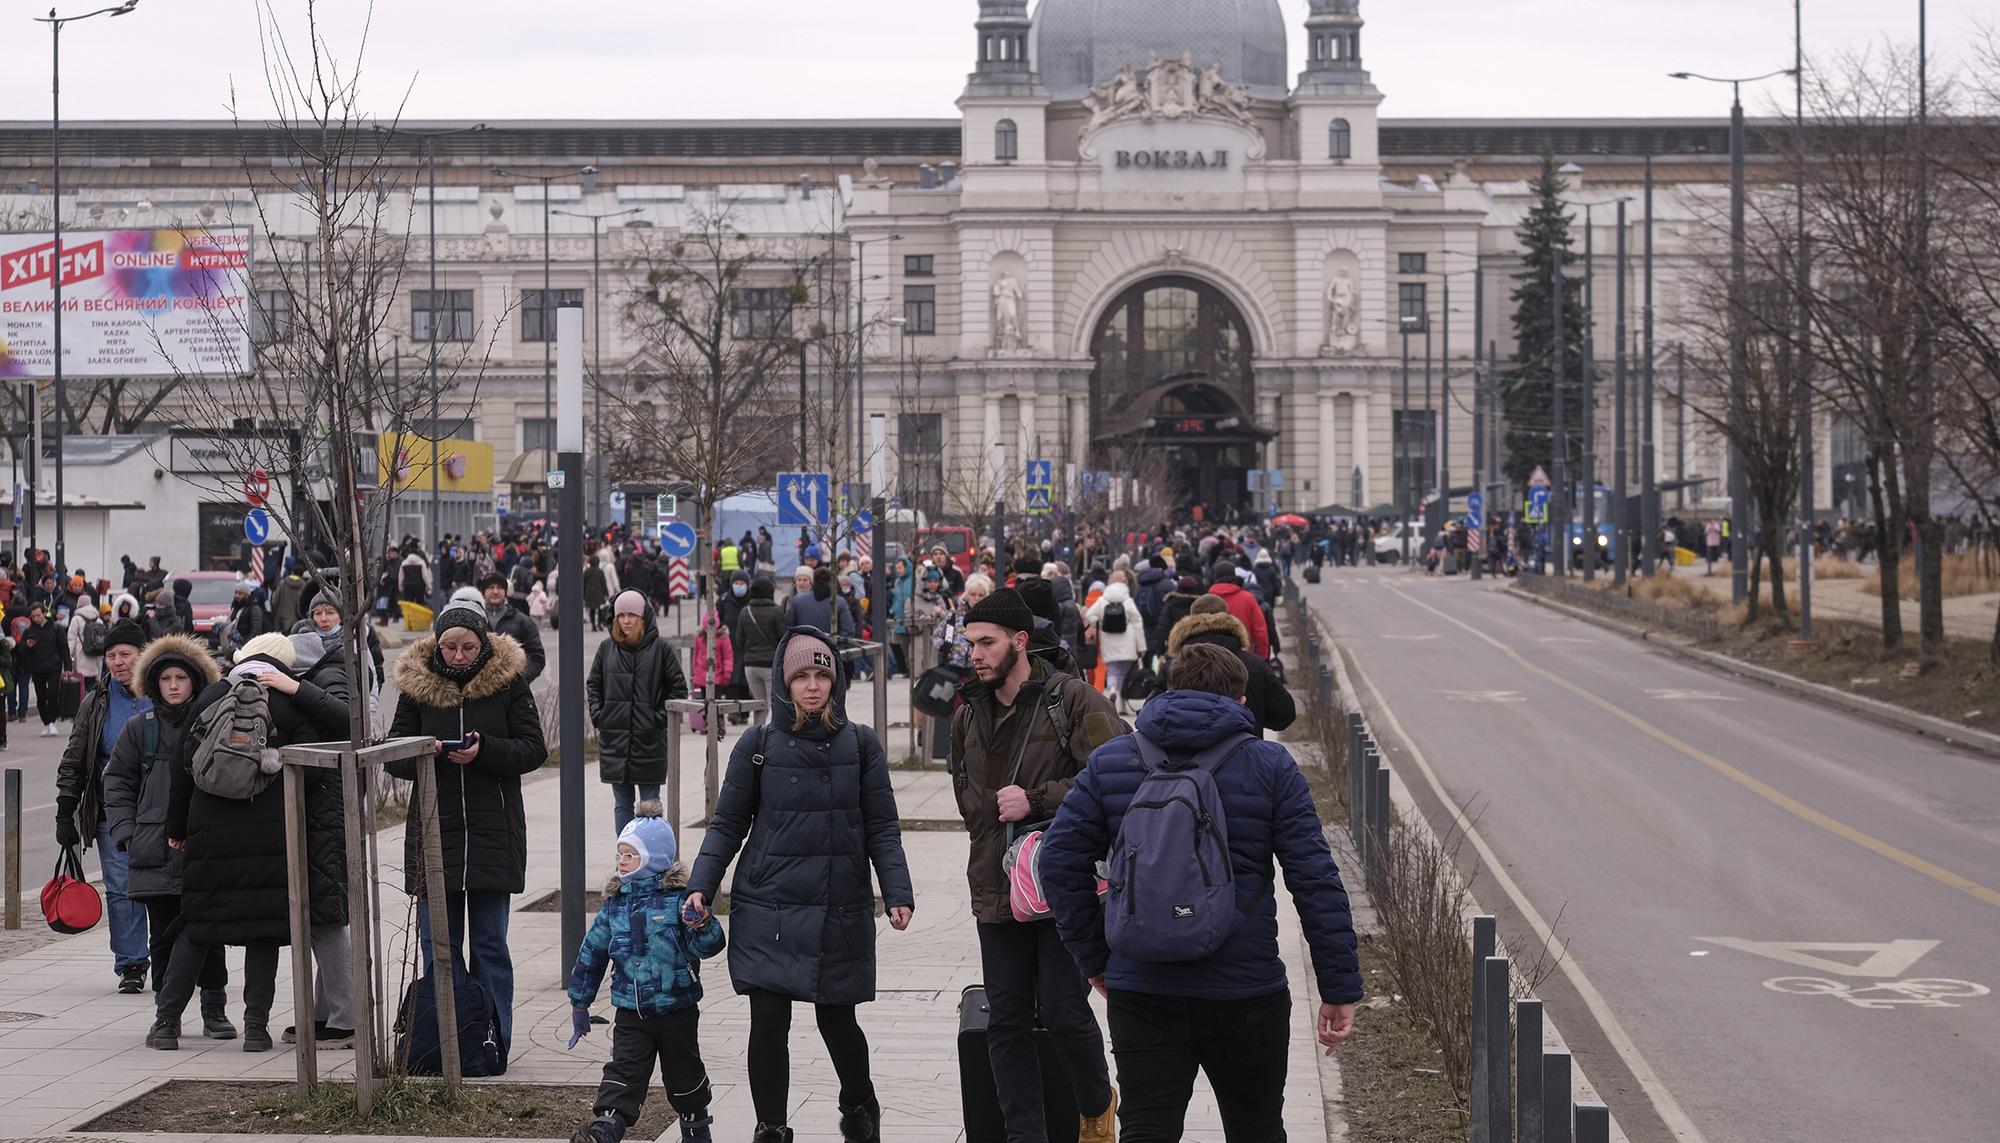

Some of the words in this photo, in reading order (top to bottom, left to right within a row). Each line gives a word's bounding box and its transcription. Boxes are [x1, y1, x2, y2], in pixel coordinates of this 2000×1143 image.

[1115, 150, 1228, 169] ВОКЗАЛ
[59, 248, 97, 281] FM
[113, 252, 175, 266] ONLINE
[3, 297, 79, 313] ВЕЛИКИЙ
[84, 296, 168, 312] ВЕСНЯНИЙ
[173, 296, 245, 311] КОНЦЕРТ
[7, 321, 43, 329] MONATIK
[7, 339, 47, 347] АНТИТІЛА
